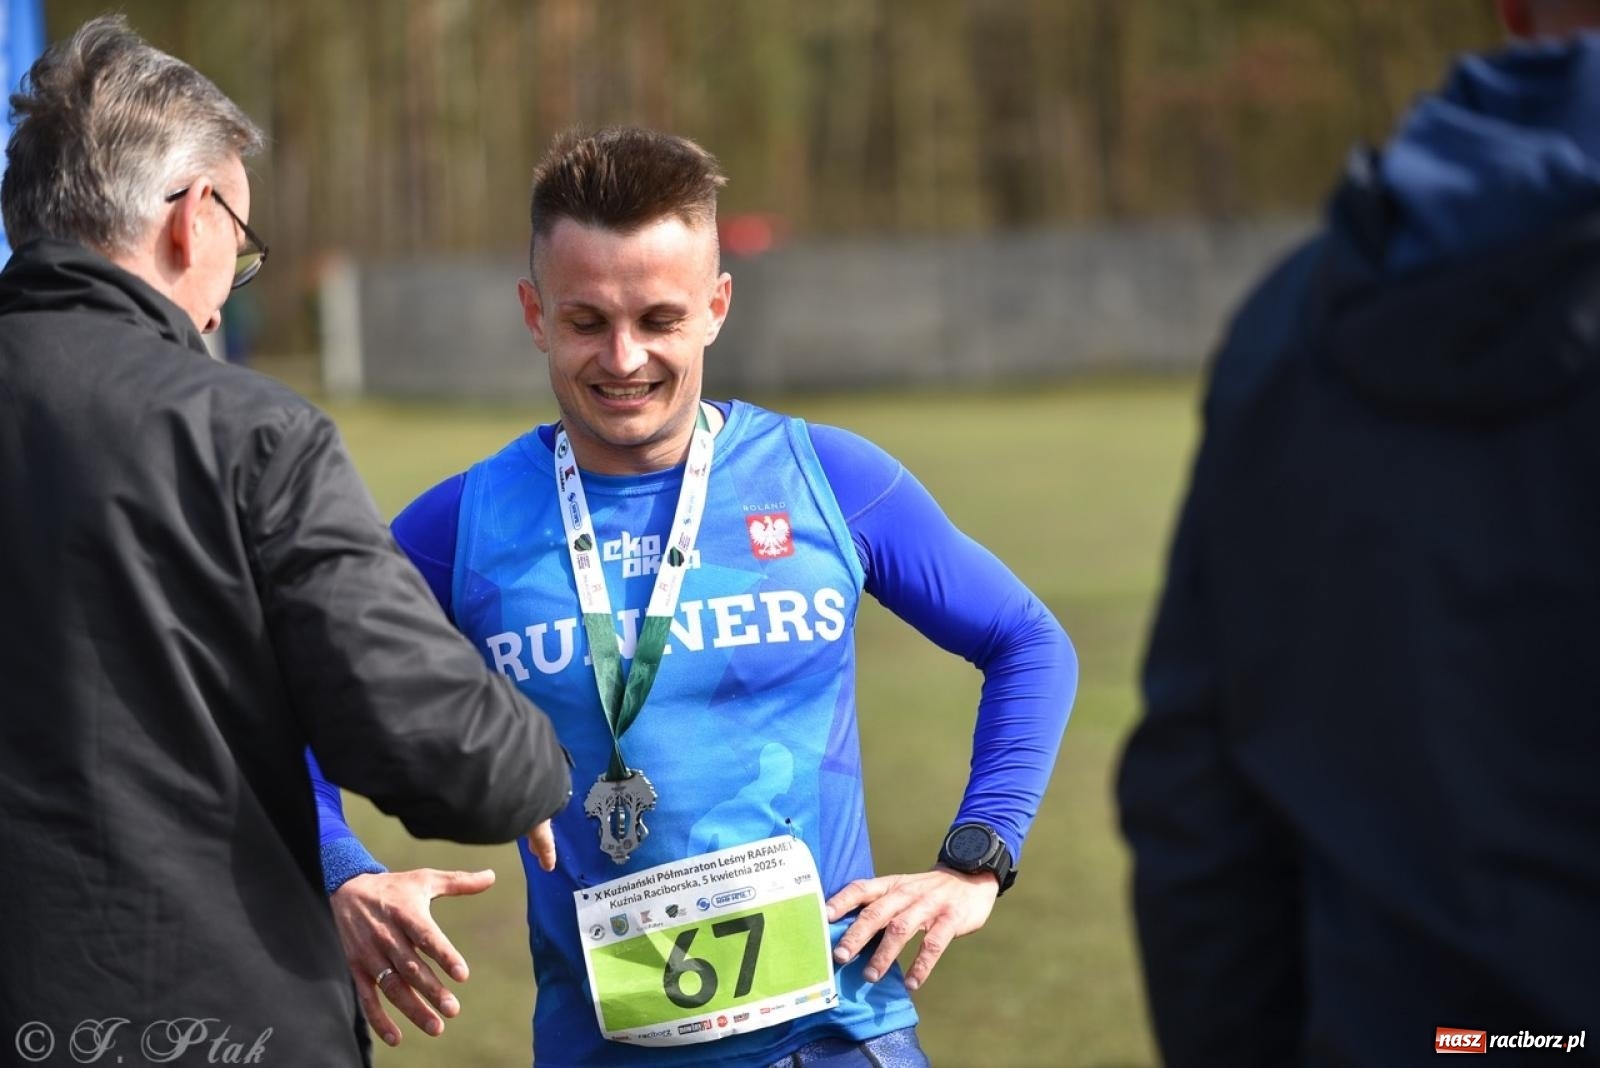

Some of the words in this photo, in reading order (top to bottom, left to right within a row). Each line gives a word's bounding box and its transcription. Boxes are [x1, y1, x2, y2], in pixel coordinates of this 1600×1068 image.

[486, 587, 846, 682] RUNNERS
[594, 890, 602, 901] X
[656, 861, 717, 882] Półmaraton
[718, 852, 746, 868] Leśny
[747, 841, 793, 860] RAFAMET
[609, 892, 642, 910] Kuźnia
[643, 875, 700, 899] Raciborska,
[702, 876, 709, 886] 5
[710, 867, 752, 884] kwietnia
[754, 858, 778, 873] 2025
[663, 912, 765, 1009] 67
